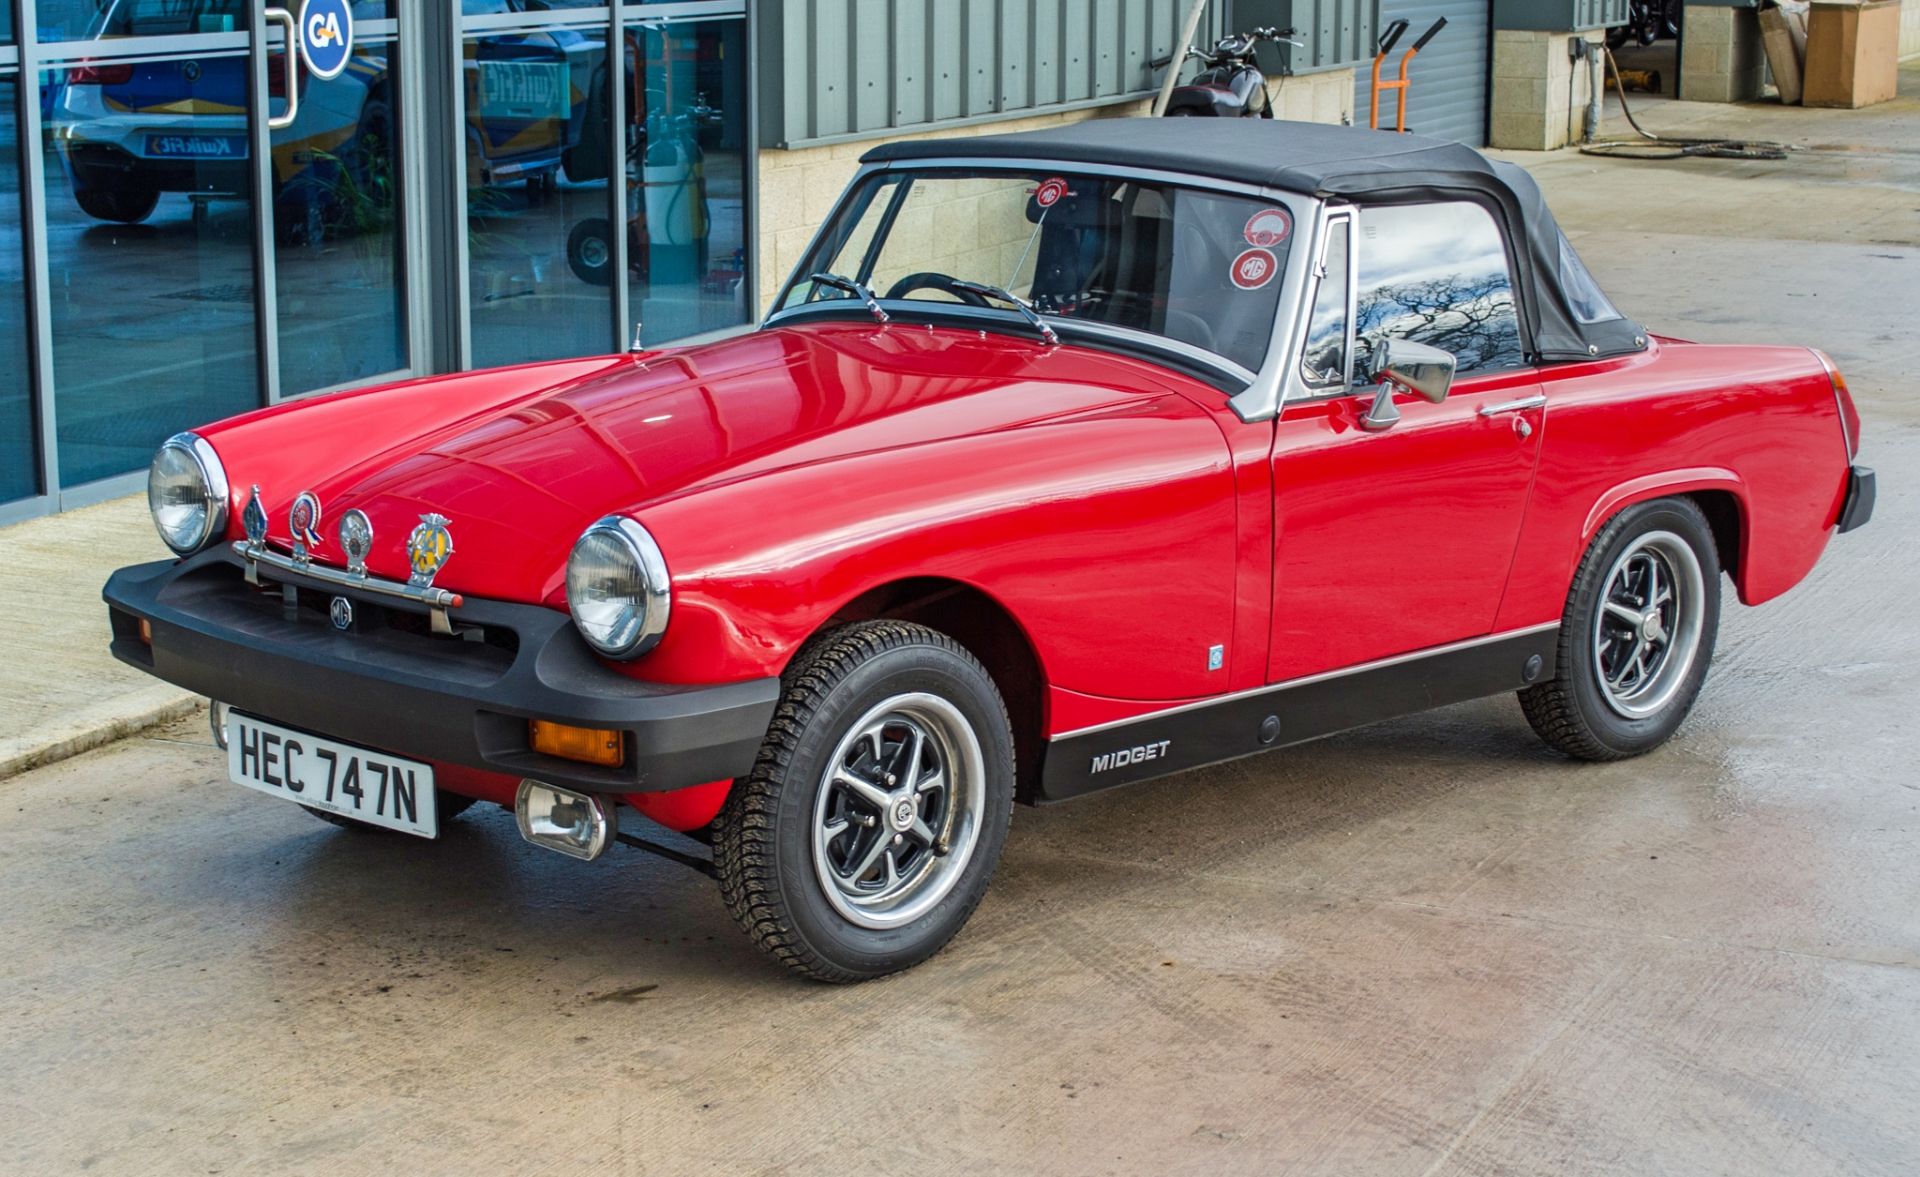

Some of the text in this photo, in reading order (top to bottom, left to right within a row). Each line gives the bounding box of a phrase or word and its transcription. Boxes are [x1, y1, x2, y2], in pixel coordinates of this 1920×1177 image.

[308, 12, 344, 48] GA
[240, 725, 417, 823] HEC 747N
[1091, 740, 1171, 774] MIDGET
